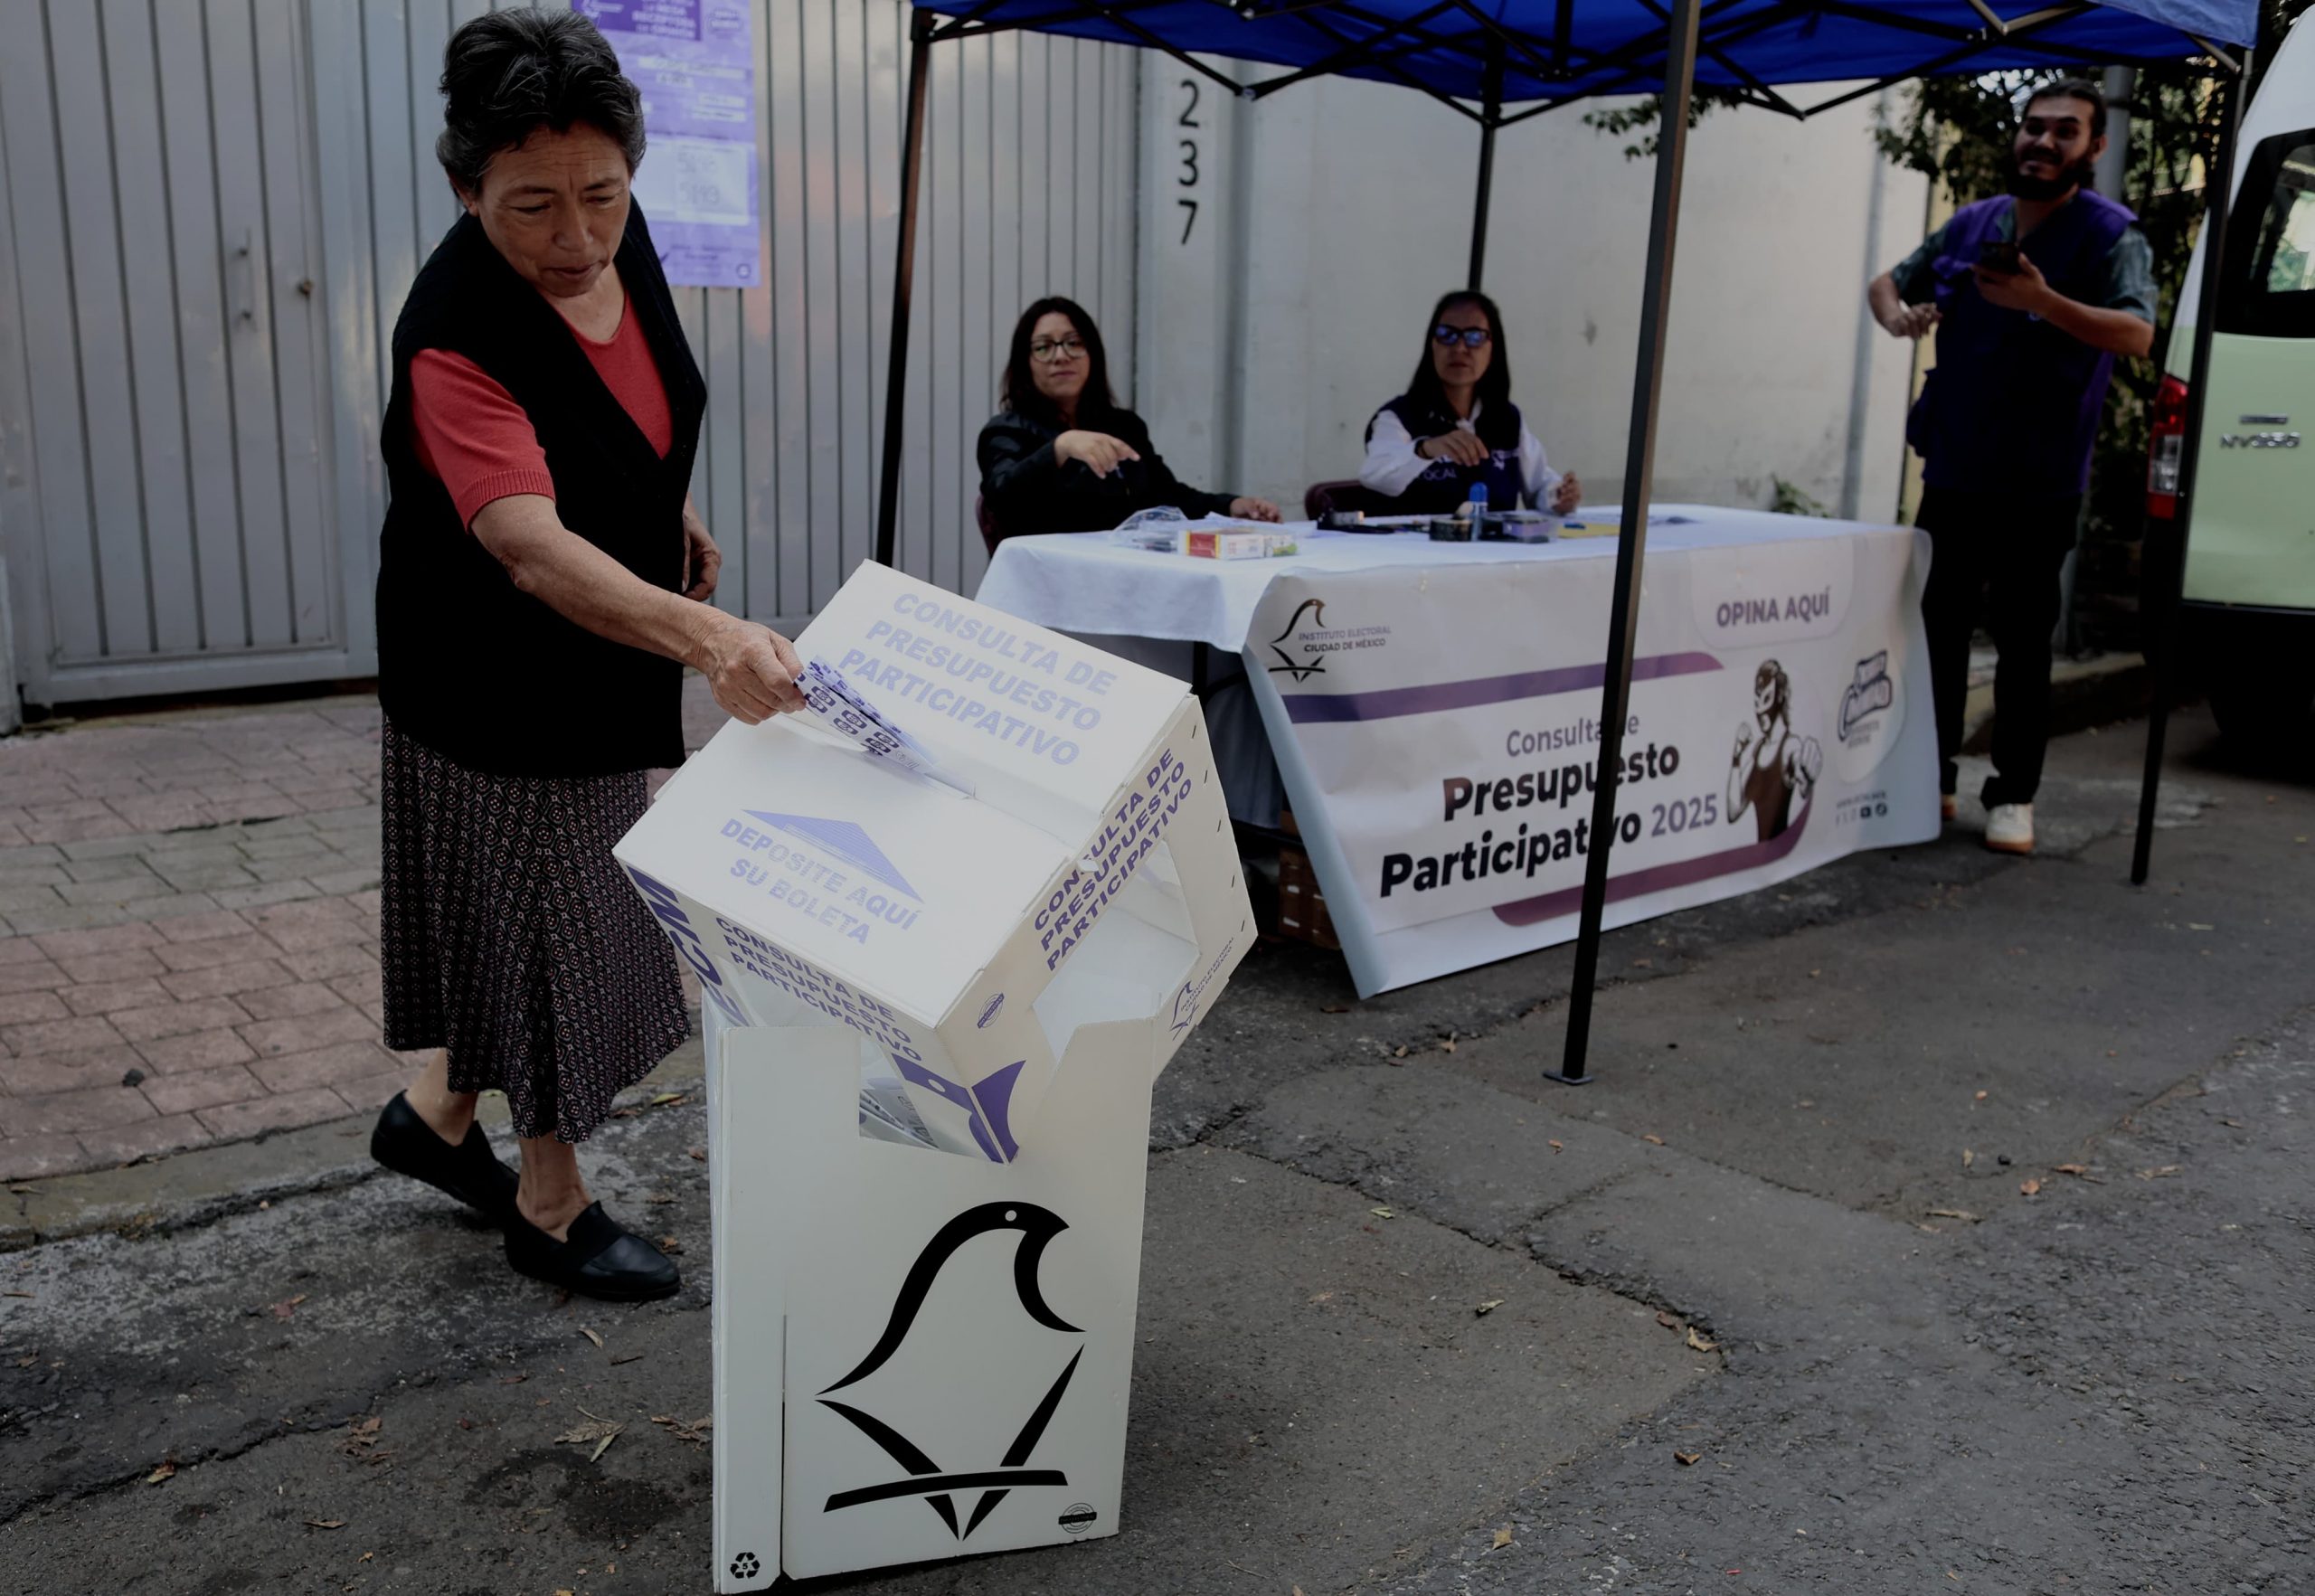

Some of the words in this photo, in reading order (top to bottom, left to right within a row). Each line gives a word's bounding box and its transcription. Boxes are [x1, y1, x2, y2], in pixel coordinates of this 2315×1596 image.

[893, 593, 1059, 675] CONSULTA
[1064, 660, 1119, 695] DE
[1299, 629, 1346, 641] INSTITUTO
[1347, 626, 1391, 637] ELECTORAL
[1304, 643, 1340, 652] CIUDAD
[1342, 641, 1353, 650] DE
[1356, 637, 1386, 648] MÉXICO
[1717, 598, 1779, 628] OPINA
[1785, 585, 1831, 624] AQUÍ
[837, 648, 1080, 766] PARTICIPATIVO
[865, 619, 1101, 731] PRESUPUESTO
[1507, 718, 1602, 757] Consulta
[720, 817, 847, 893] DEPOSITE
[845, 886, 923, 930] AQUÍ
[1035, 792, 1144, 930] CONULTA
[1146, 748, 1174, 789] DE
[1041, 761, 1185, 951] PRESUPUESTO
[1046, 779, 1192, 971] PARTICIPATIVO
[1380, 812, 1641, 898] Participatvo
[1651, 793, 1717, 837] 2025
[730, 858, 769, 886] SU
[769, 878, 870, 944] BOLETA
[715, 917, 853, 999] CONSULTA
[858, 993, 896, 1023] DE
[723, 934, 912, 1044] PRESUPUESTO
[730, 951, 922, 1062] PARTICIPATIVO
